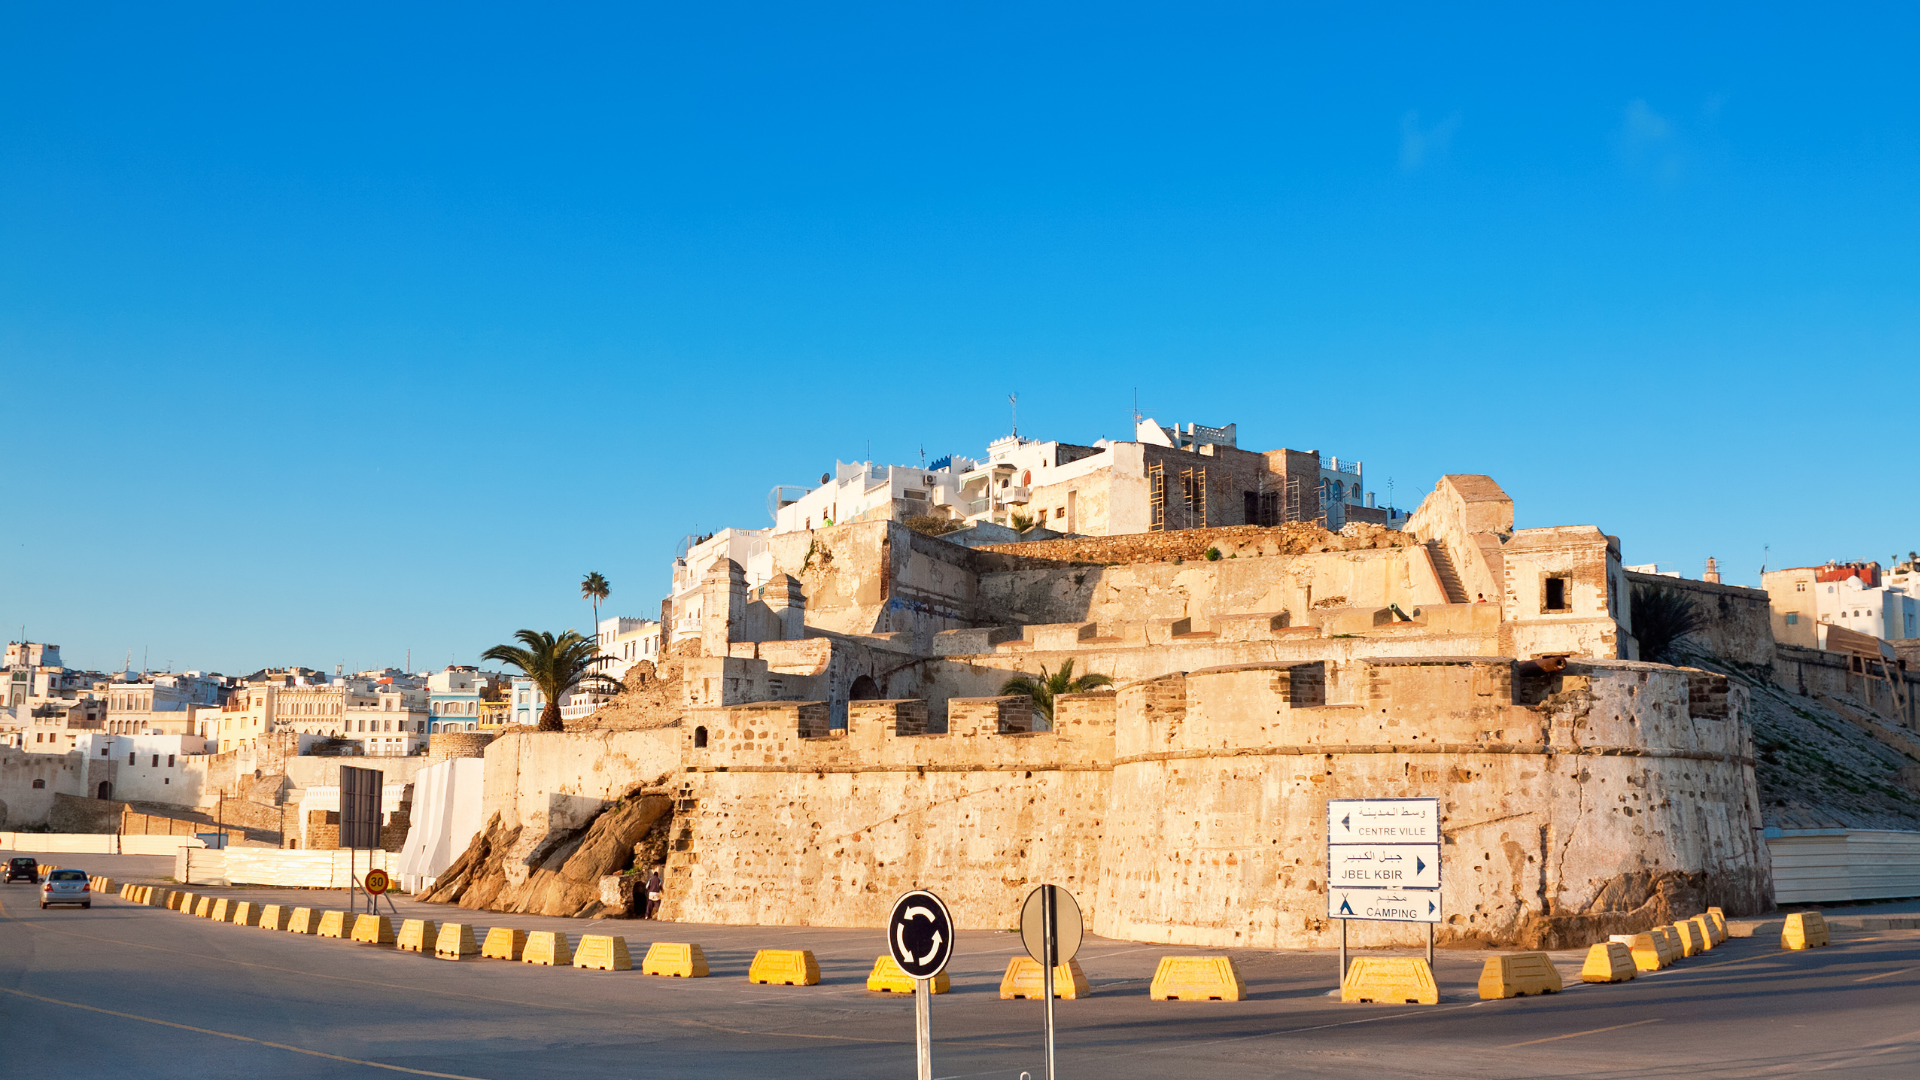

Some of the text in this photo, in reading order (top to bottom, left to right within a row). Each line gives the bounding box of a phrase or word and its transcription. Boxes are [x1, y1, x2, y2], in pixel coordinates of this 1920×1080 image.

[1358, 806, 1426, 819] وسط المدينة
[1358, 827, 1426, 836] CENTRE VILLE
[1343, 851, 1403, 863] جبل الكبير
[1341, 870, 1403, 880] JBEL KBIR
[371, 877, 383, 887] 30
[1376, 893, 1407, 905] مخيم
[1366, 907, 1418, 919] CAMPING
